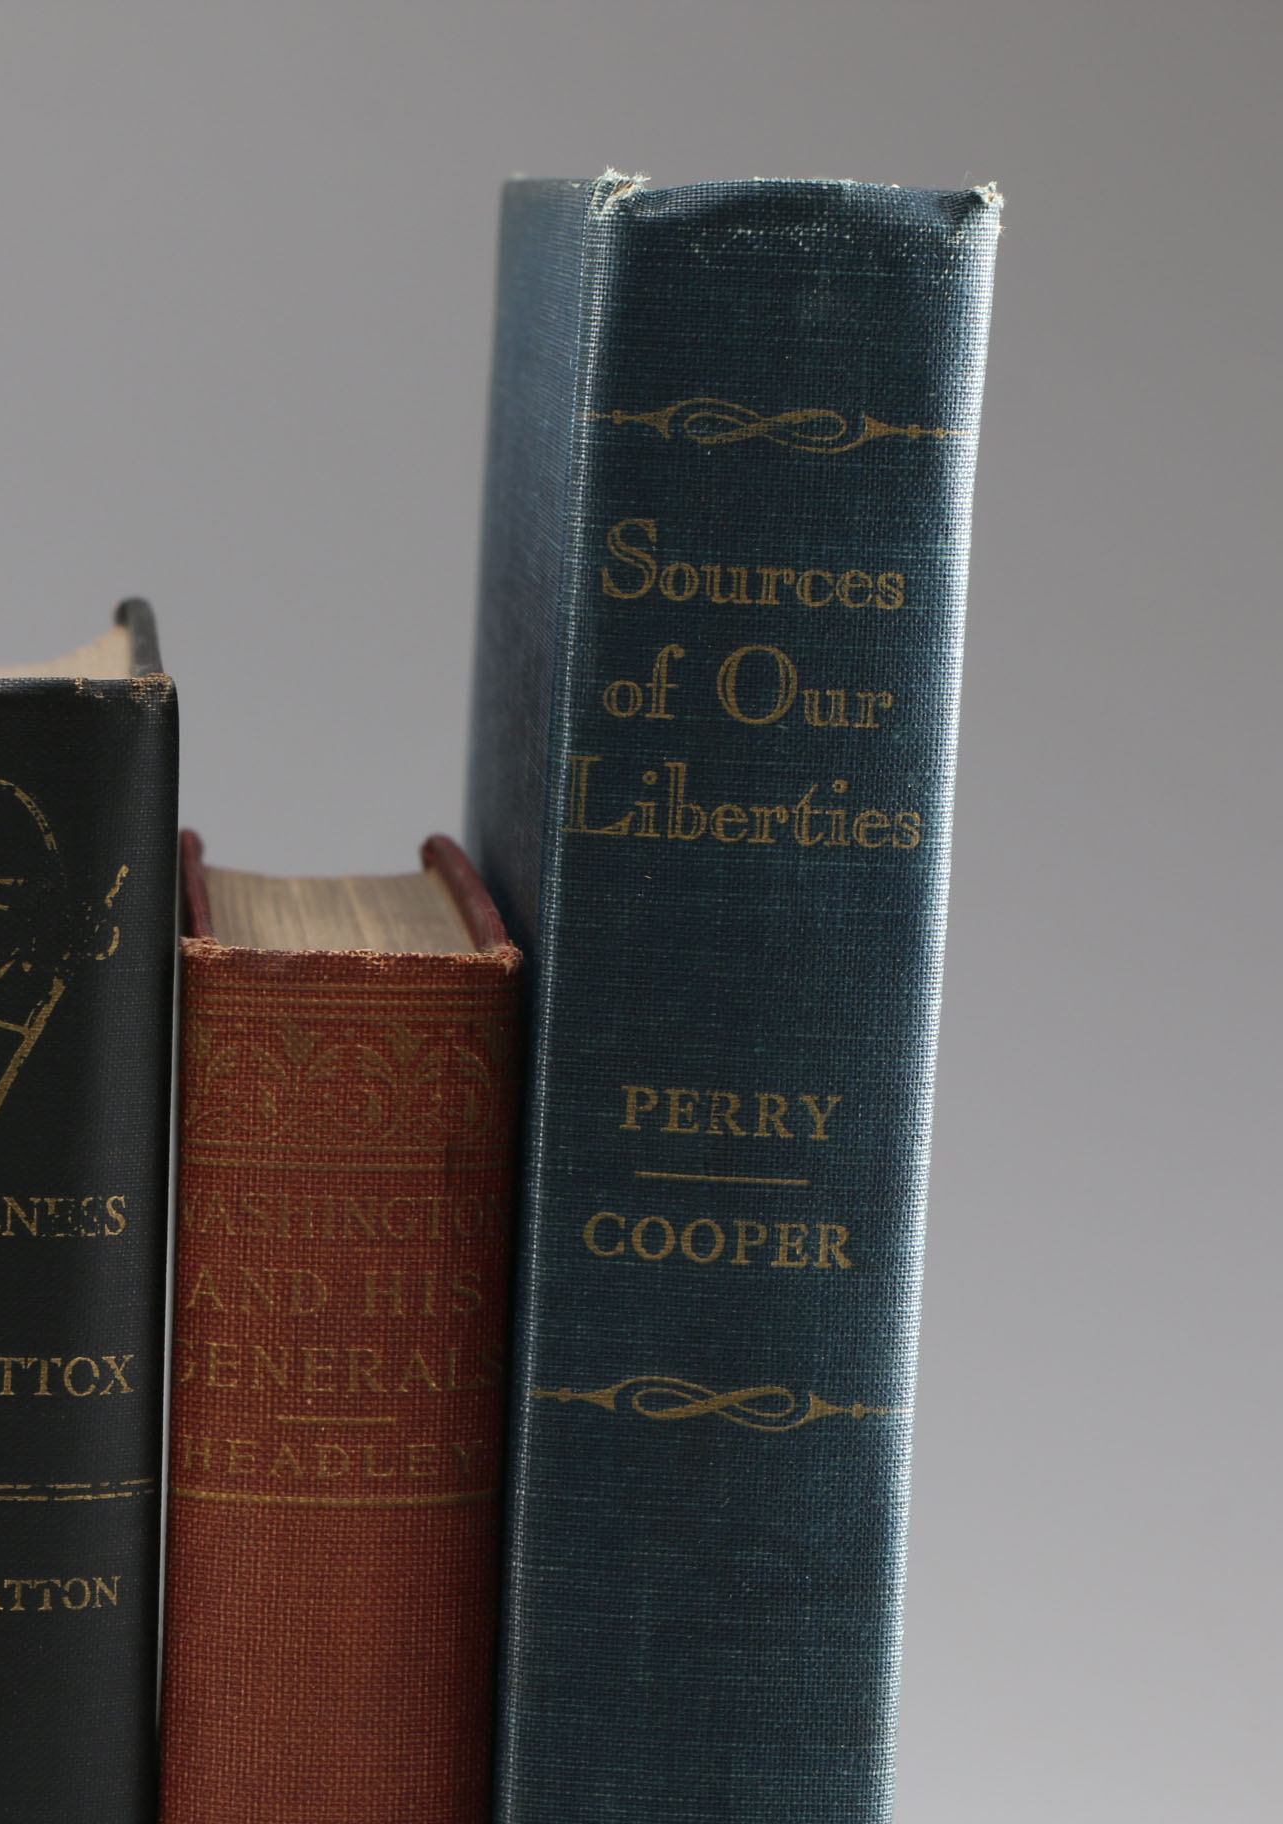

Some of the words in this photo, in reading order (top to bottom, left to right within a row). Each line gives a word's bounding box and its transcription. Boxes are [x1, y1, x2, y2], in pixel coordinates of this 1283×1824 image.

[602, 518, 906, 610] Sources
[602, 643, 685, 720] of
[717, 644, 894, 729] Our
[561, 755, 922, 850] Liberties
[619, 1085, 843, 1140] PERRY
[582, 1211, 854, 1269] COOPER
[185, 1265, 329, 1316] AND
[362, 1270, 484, 1317] HIS
[182, 1435, 485, 1479] HEADLEY
